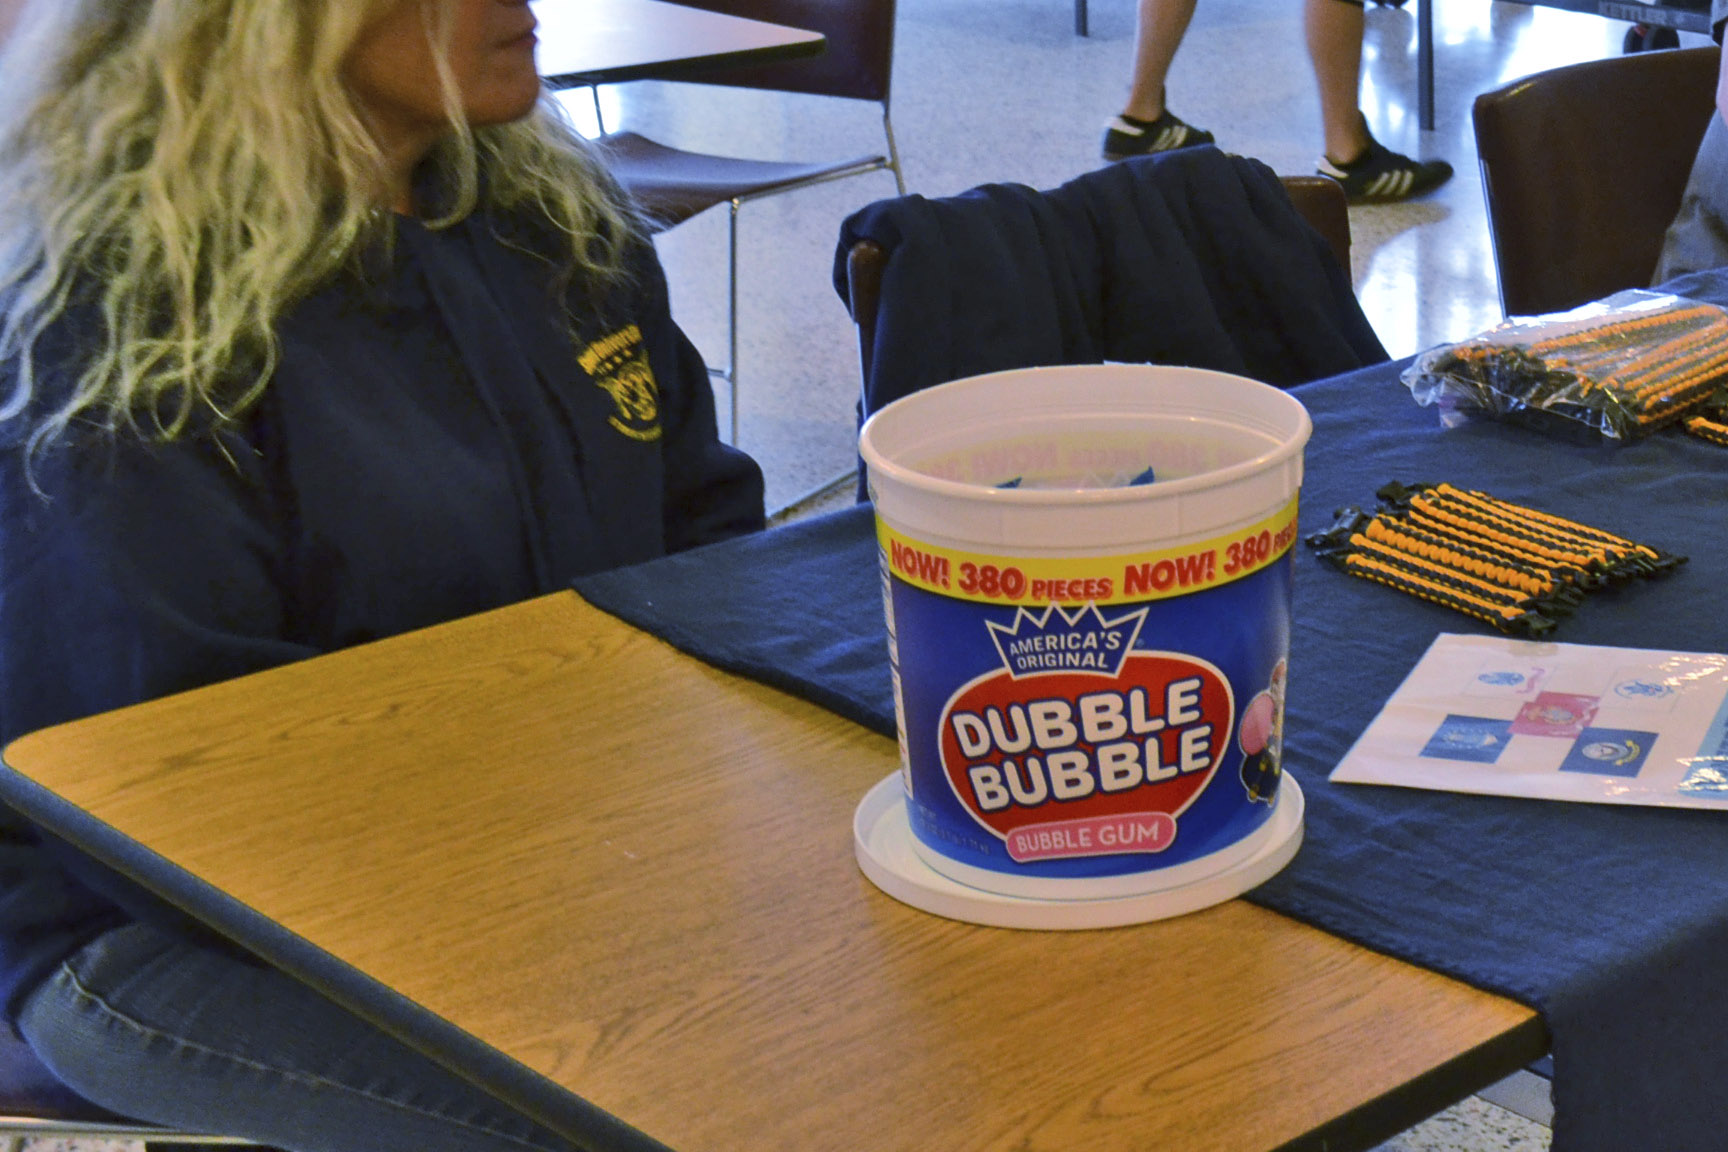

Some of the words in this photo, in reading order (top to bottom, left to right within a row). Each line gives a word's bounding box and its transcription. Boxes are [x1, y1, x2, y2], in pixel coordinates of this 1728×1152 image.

[891, 538, 950, 590] NOW!
[958, 562, 1027, 600] 380
[1031, 578, 1113, 601] PIECES
[1123, 550, 1217, 596] NOW!
[1223, 529, 1273, 576] 380
[1009, 631, 1123, 657] AMERICA'S
[1016, 652, 1109, 670] ORIGINAL
[951, 678, 1202, 758] DUBBLE
[968, 724, 1212, 811] BUBBLE
[1016, 828, 1093, 853] BUBBLE
[1098, 822, 1160, 846] GUM
